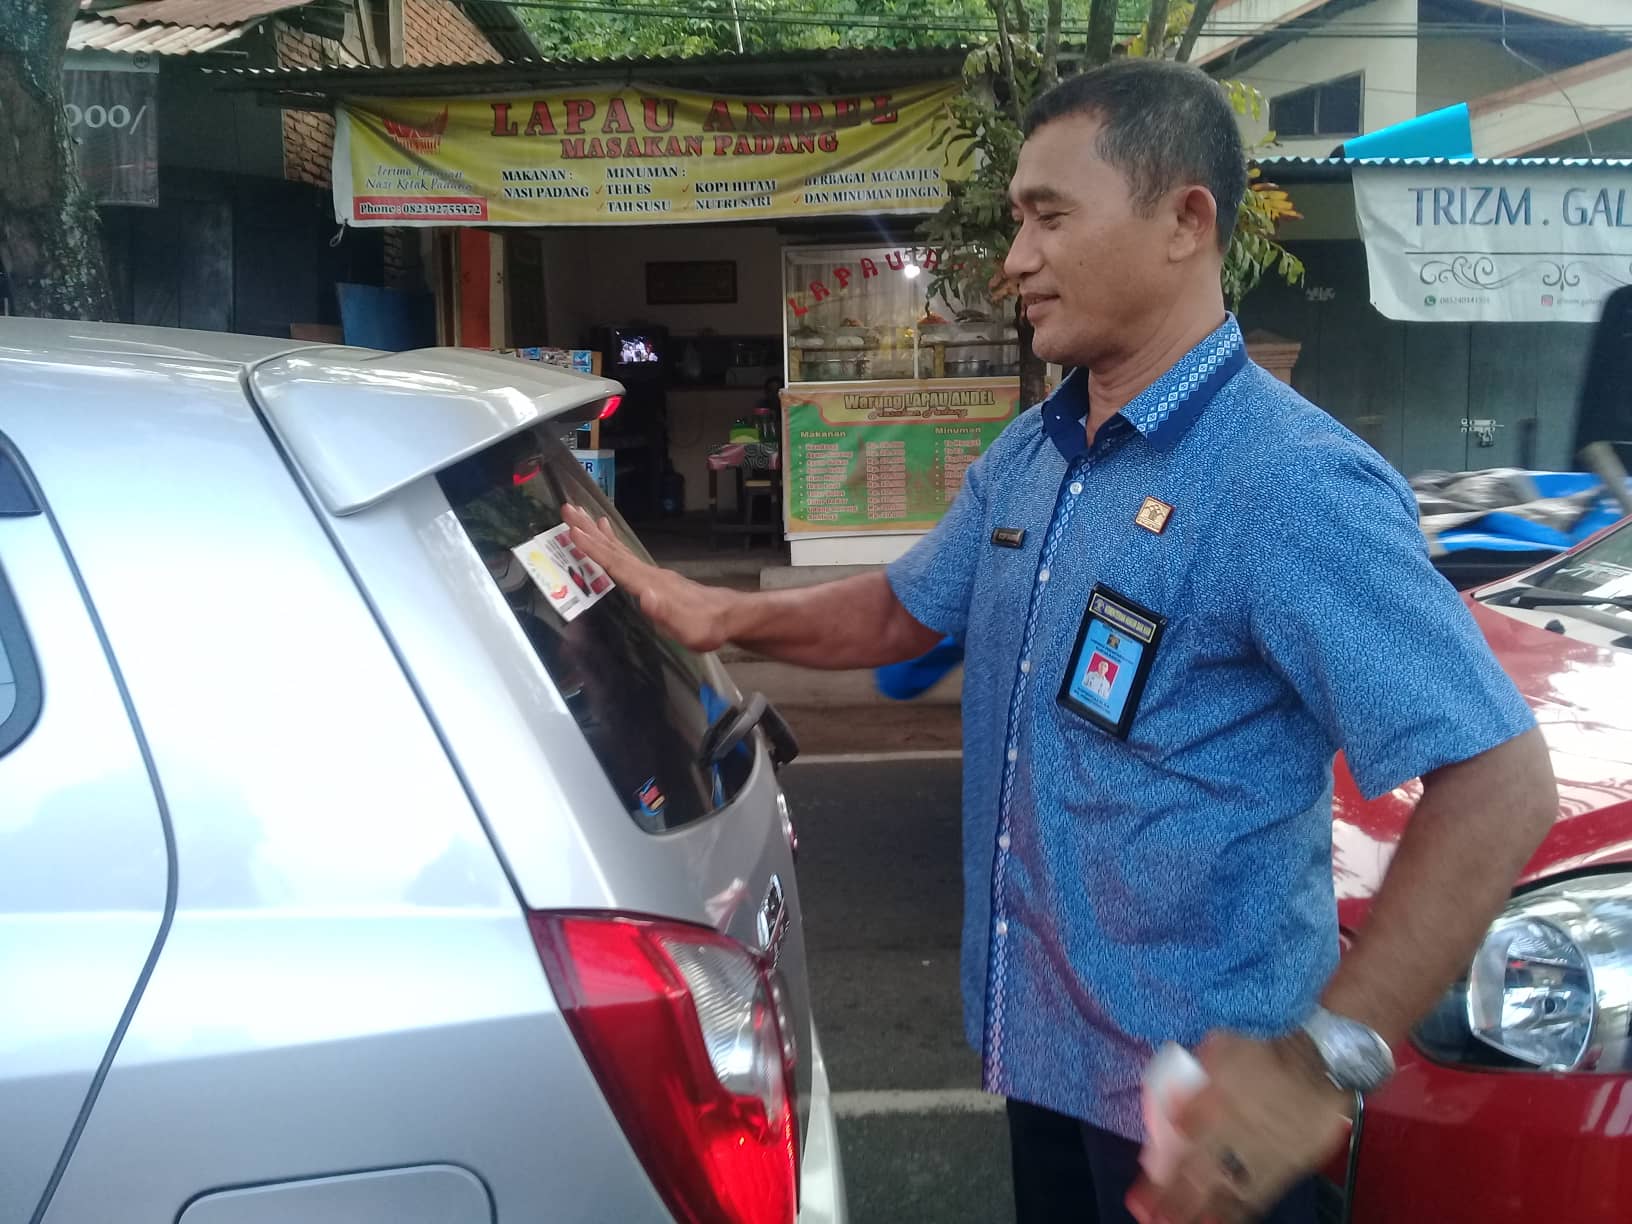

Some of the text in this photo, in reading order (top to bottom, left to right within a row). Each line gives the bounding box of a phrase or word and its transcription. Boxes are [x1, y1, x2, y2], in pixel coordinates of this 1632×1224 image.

[491, 95, 898, 136] LAPAU ANDEL
[560, 131, 839, 159] MASAKAN PADANG
[502, 170, 566, 181] MAKANAN
[607, 167, 678, 179] MINUMAN
[871, 169, 915, 183] MACAM
[918, 168, 939, 181] JUS
[504, 186, 589, 198] NASI PADANG
[607, 183, 651, 195] TEH ES
[695, 180, 776, 193] KOPI HITAM
[805, 191, 829, 204] DAN
[832, 189, 893, 202] MINUMAN
[360, 201, 395, 214] Phone
[635, 200, 671, 212] SUSU
[1408, 187, 1531, 226] TRIZM
[788, 251, 905, 317] LAPAU
[844, 391, 995, 409] Warung LAPAU ANDEL
[800, 431, 846, 439] Makanan
